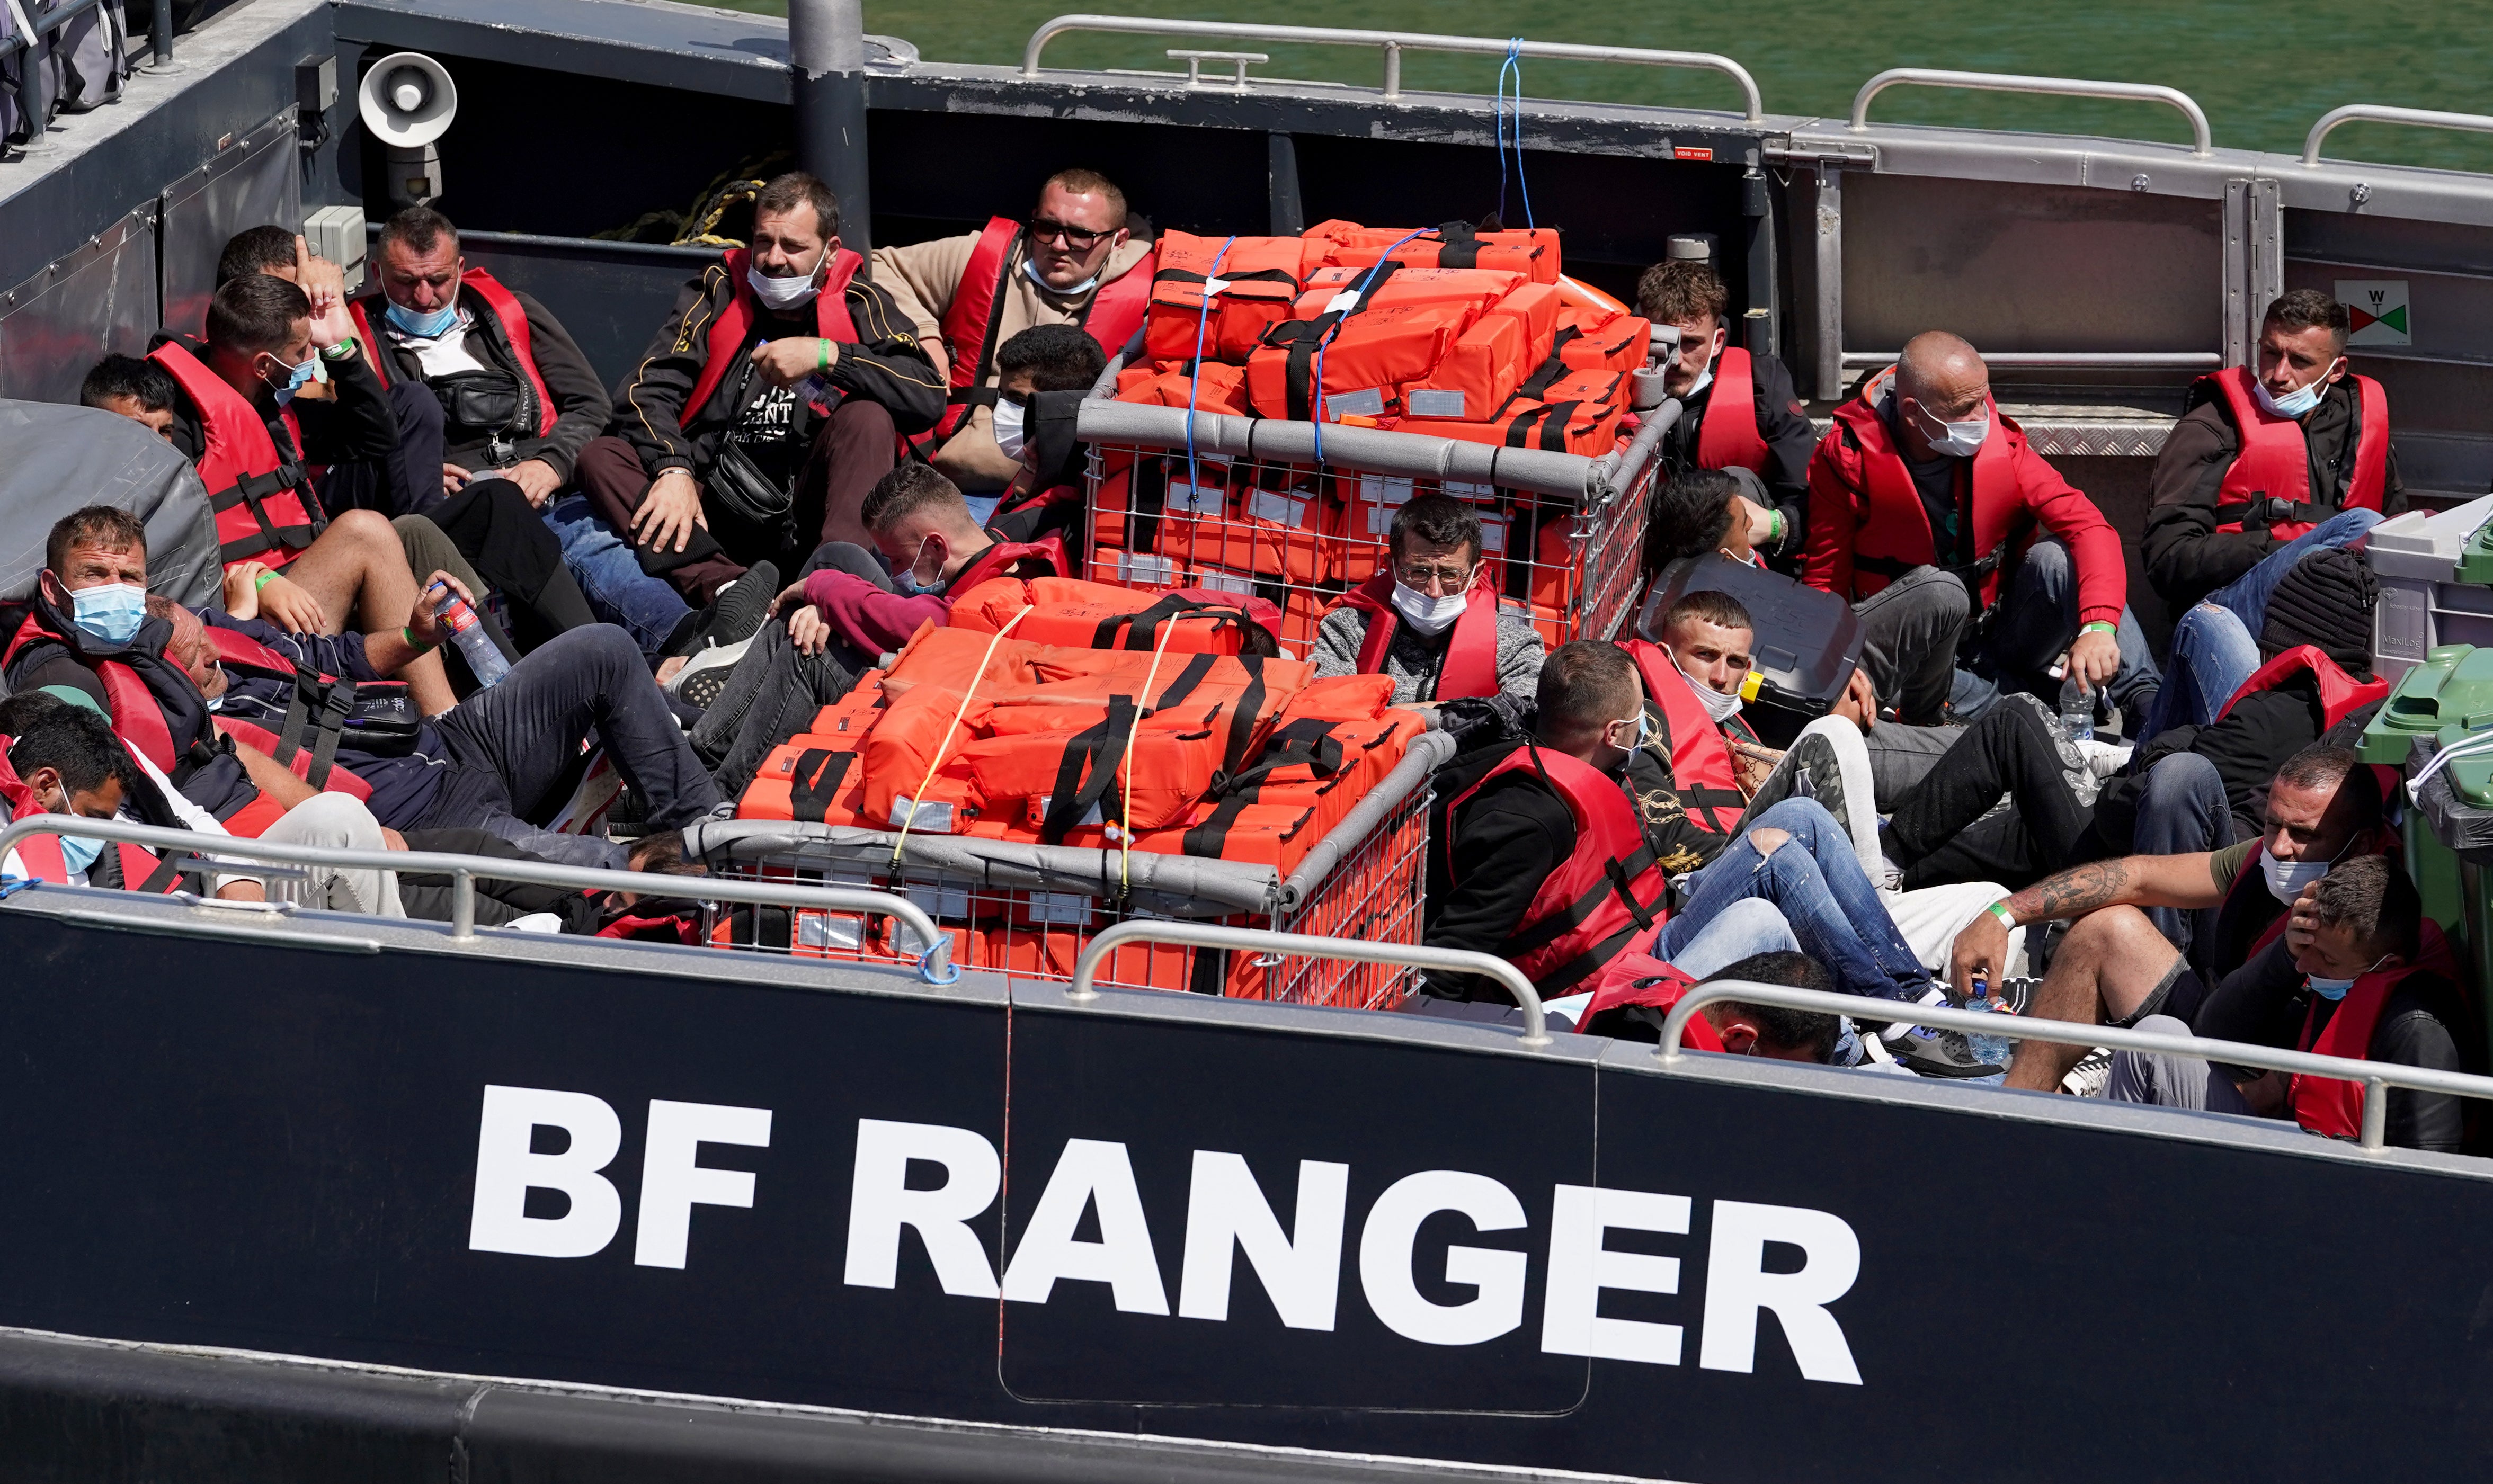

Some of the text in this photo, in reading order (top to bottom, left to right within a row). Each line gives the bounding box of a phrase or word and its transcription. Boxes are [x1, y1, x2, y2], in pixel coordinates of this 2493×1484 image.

[2368, 290, 2384, 302] W
[469, 1085, 1863, 1385] BF RANGER
